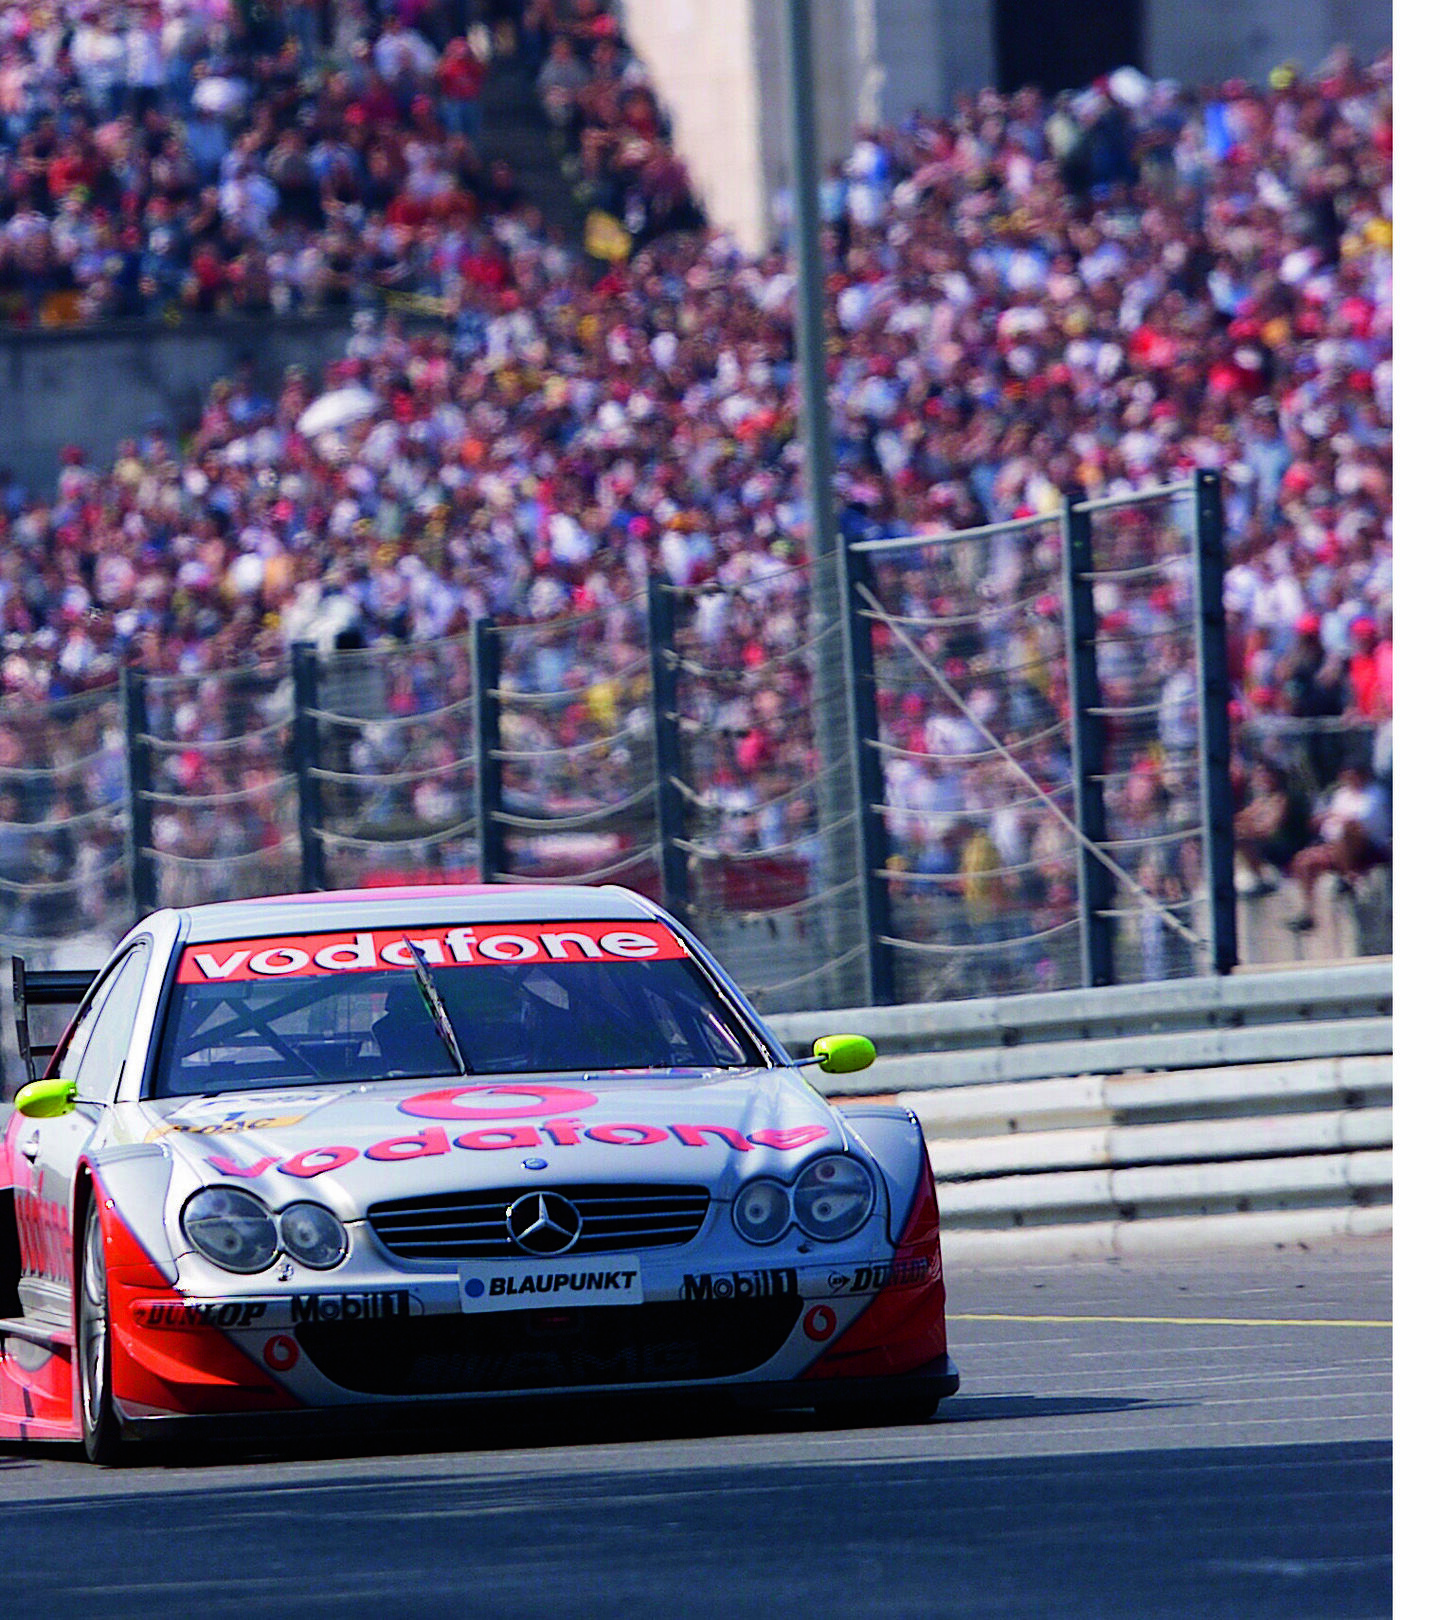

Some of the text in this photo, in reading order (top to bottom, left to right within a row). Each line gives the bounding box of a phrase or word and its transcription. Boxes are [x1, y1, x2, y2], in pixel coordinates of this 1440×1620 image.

[194, 928, 659, 979] vodafone
[203, 1117, 830, 1178] vodafone
[489, 1270, 637, 1296] BLAUPUNKT
[146, 1303, 267, 1327] DUNLOP
